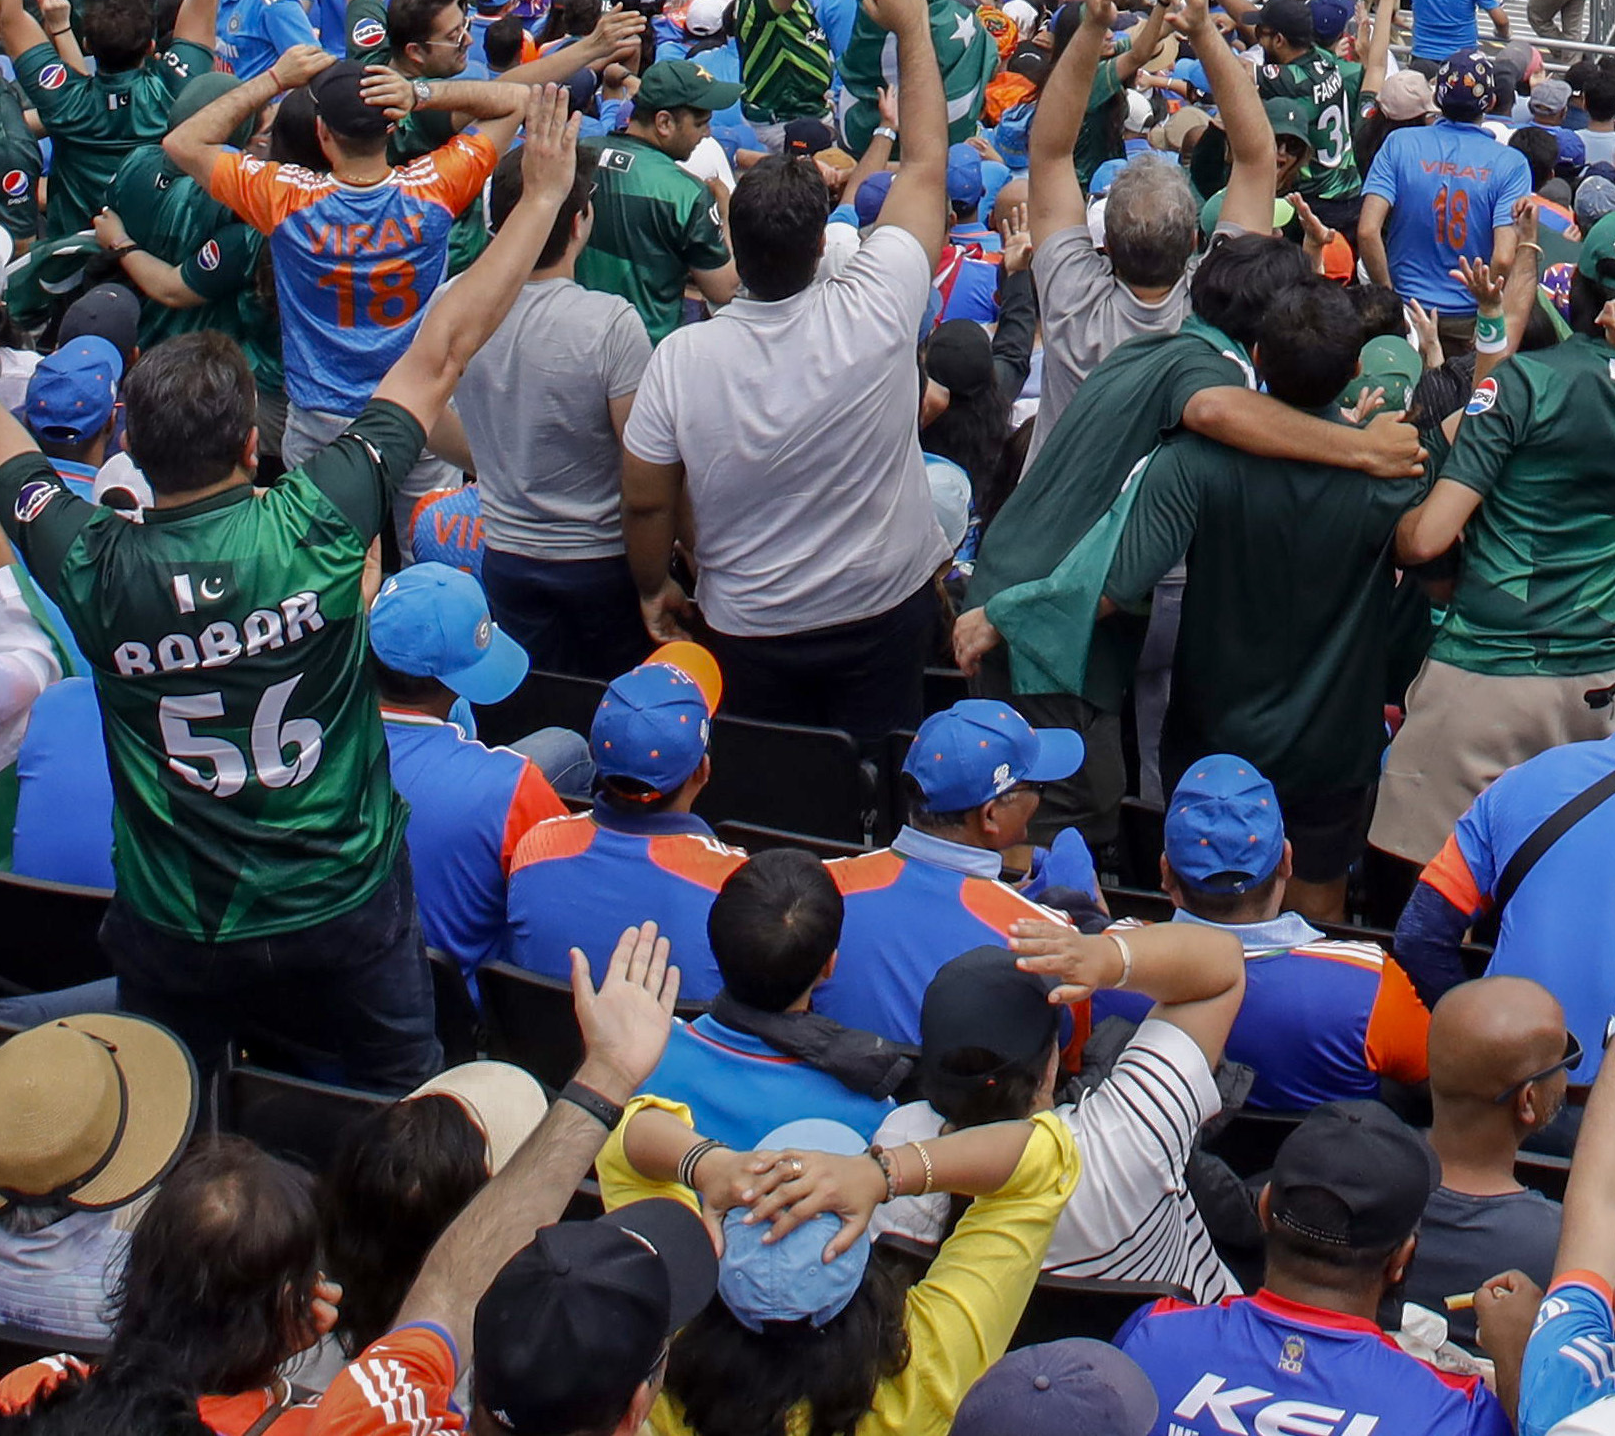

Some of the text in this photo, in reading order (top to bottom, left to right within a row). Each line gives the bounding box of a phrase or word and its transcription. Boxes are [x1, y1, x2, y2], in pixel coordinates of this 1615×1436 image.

[1419, 159, 1492, 184] VIRAT
[303, 212, 426, 261] VIRAT
[1431, 185, 1470, 251] 18
[316, 259, 421, 330] 18
[112, 588, 326, 678] BABAR
[157, 672, 324, 800] 56
